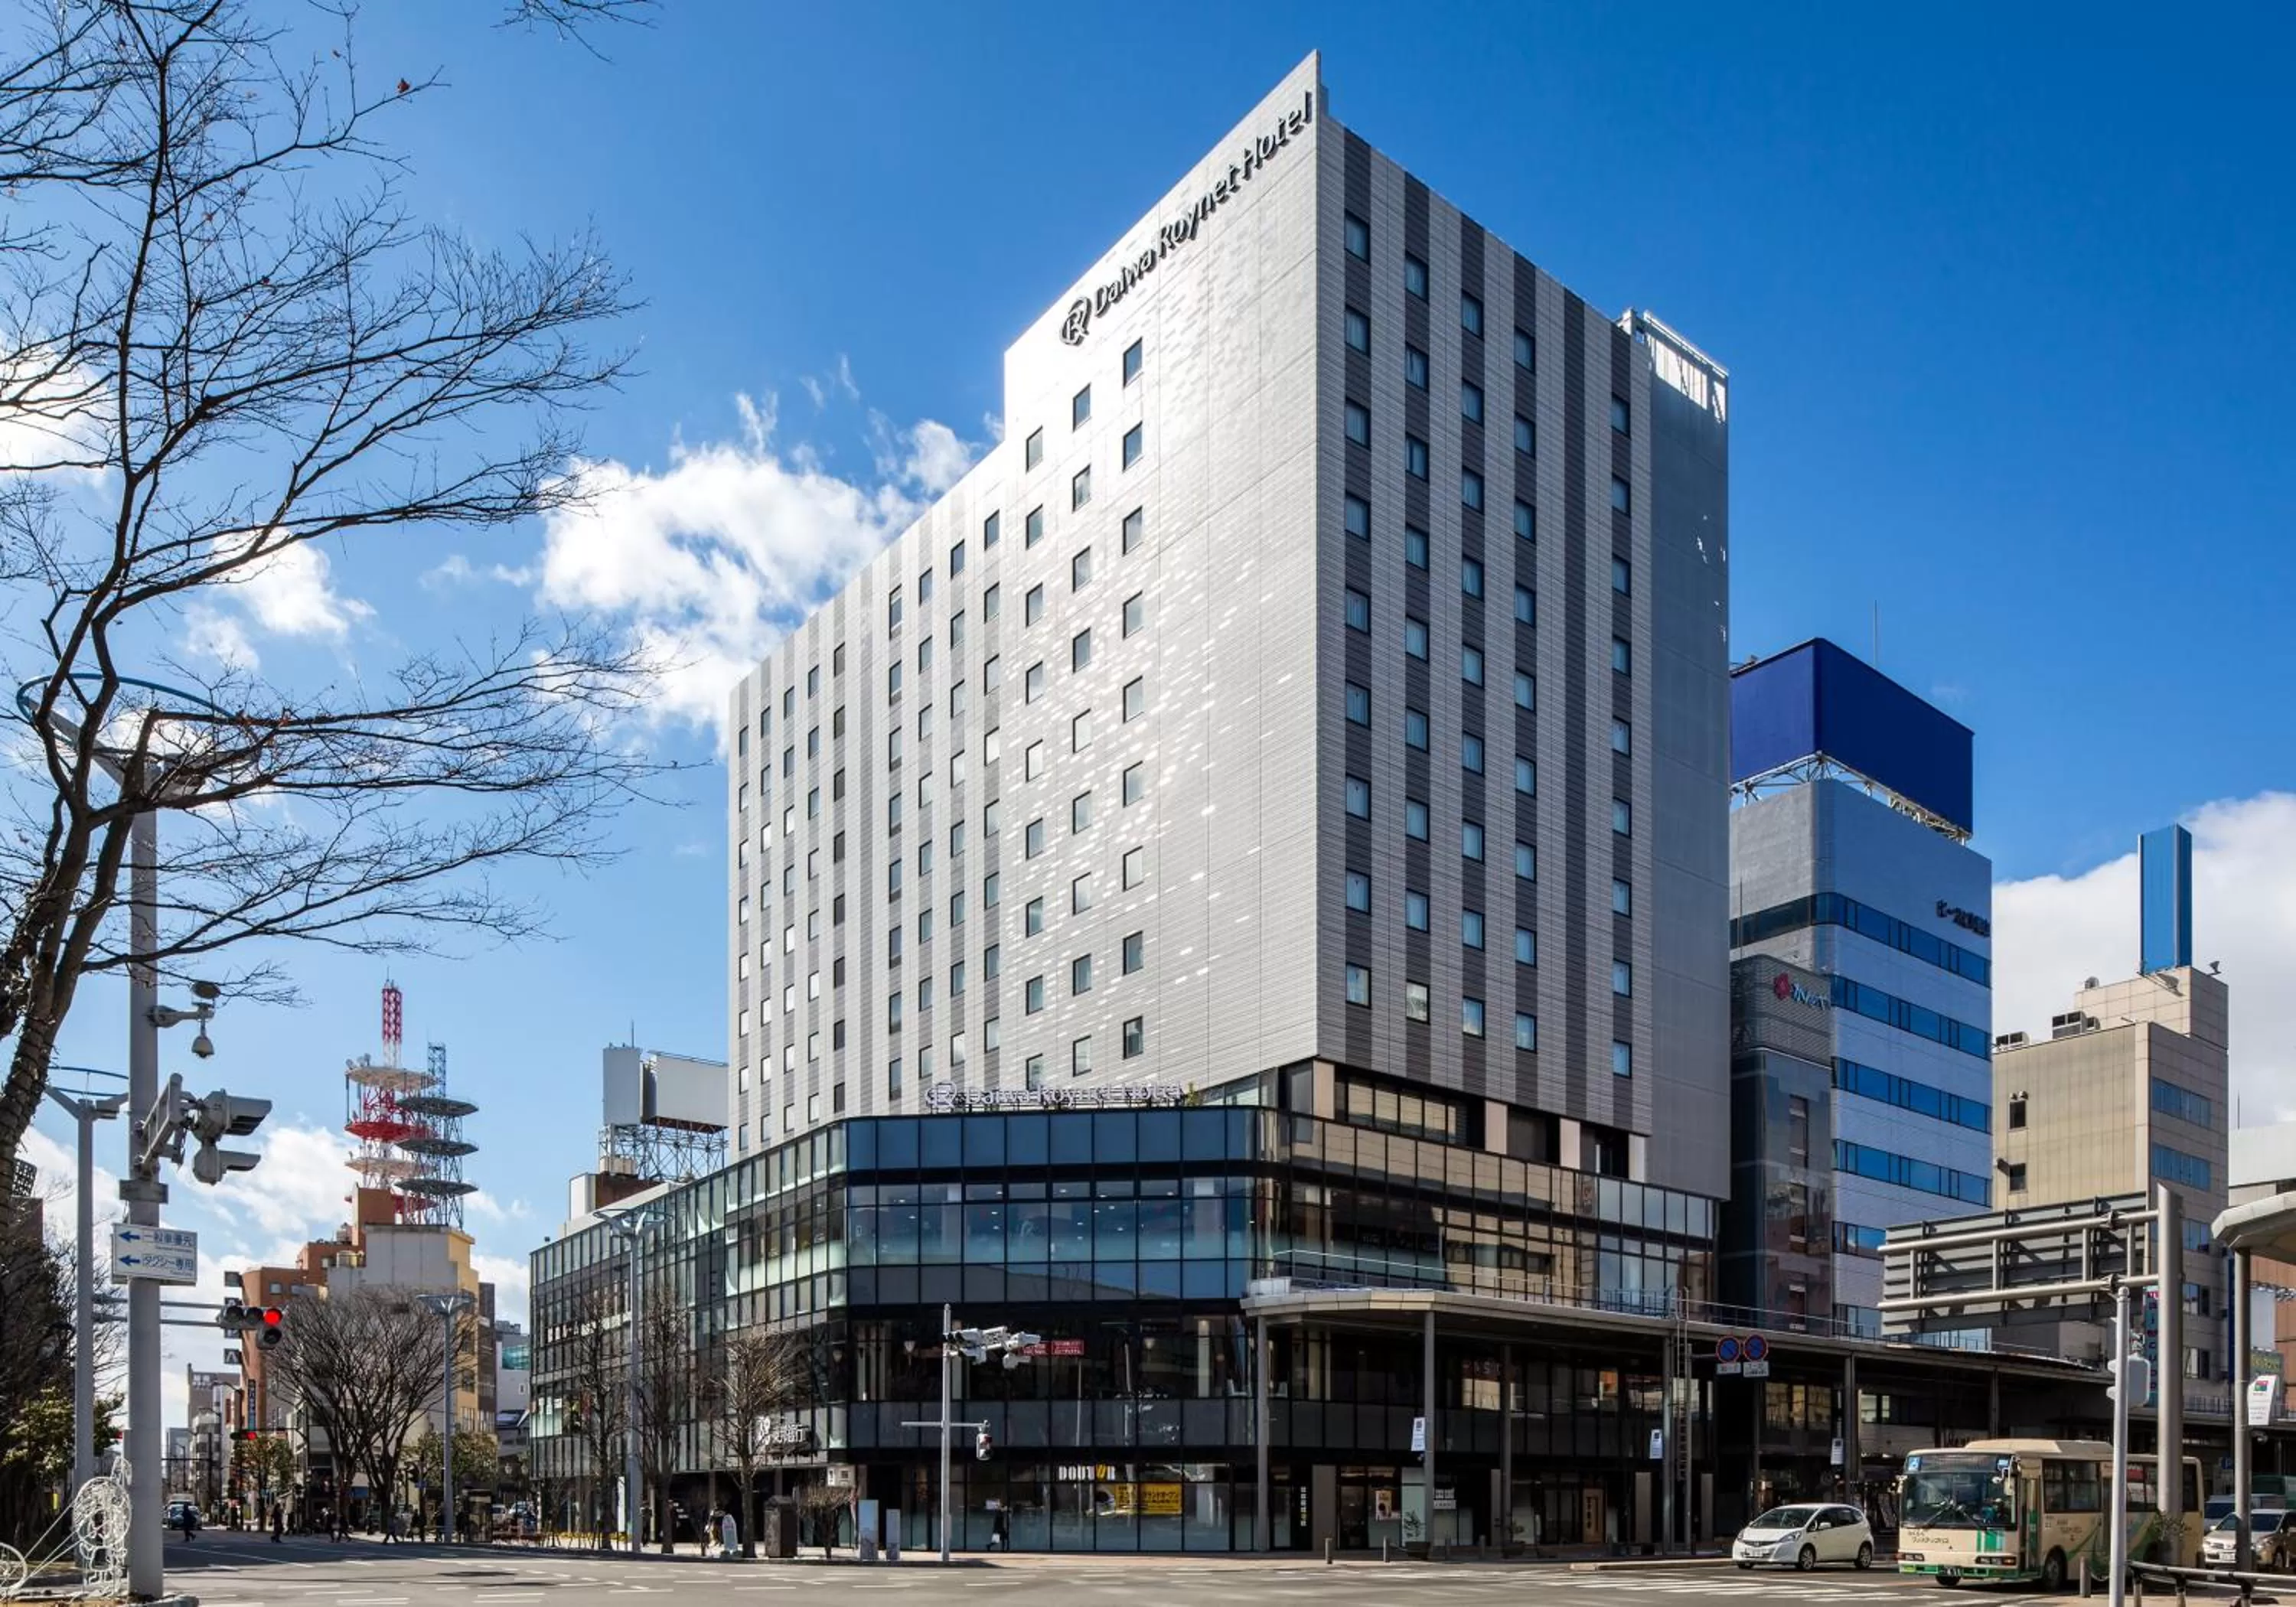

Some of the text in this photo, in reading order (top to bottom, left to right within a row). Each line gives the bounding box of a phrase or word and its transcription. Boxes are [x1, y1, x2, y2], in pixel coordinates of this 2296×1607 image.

[1094, 248, 1157, 318] Daiwa
[1156, 164, 1241, 259] Roynet
[1241, 90, 1313, 181] Hotel
[965, 1084, 1029, 1105] Daiwa
[142, 1255, 194, 1270] タクシー専用
[1058, 1464, 1115, 1481] DOUTOR
